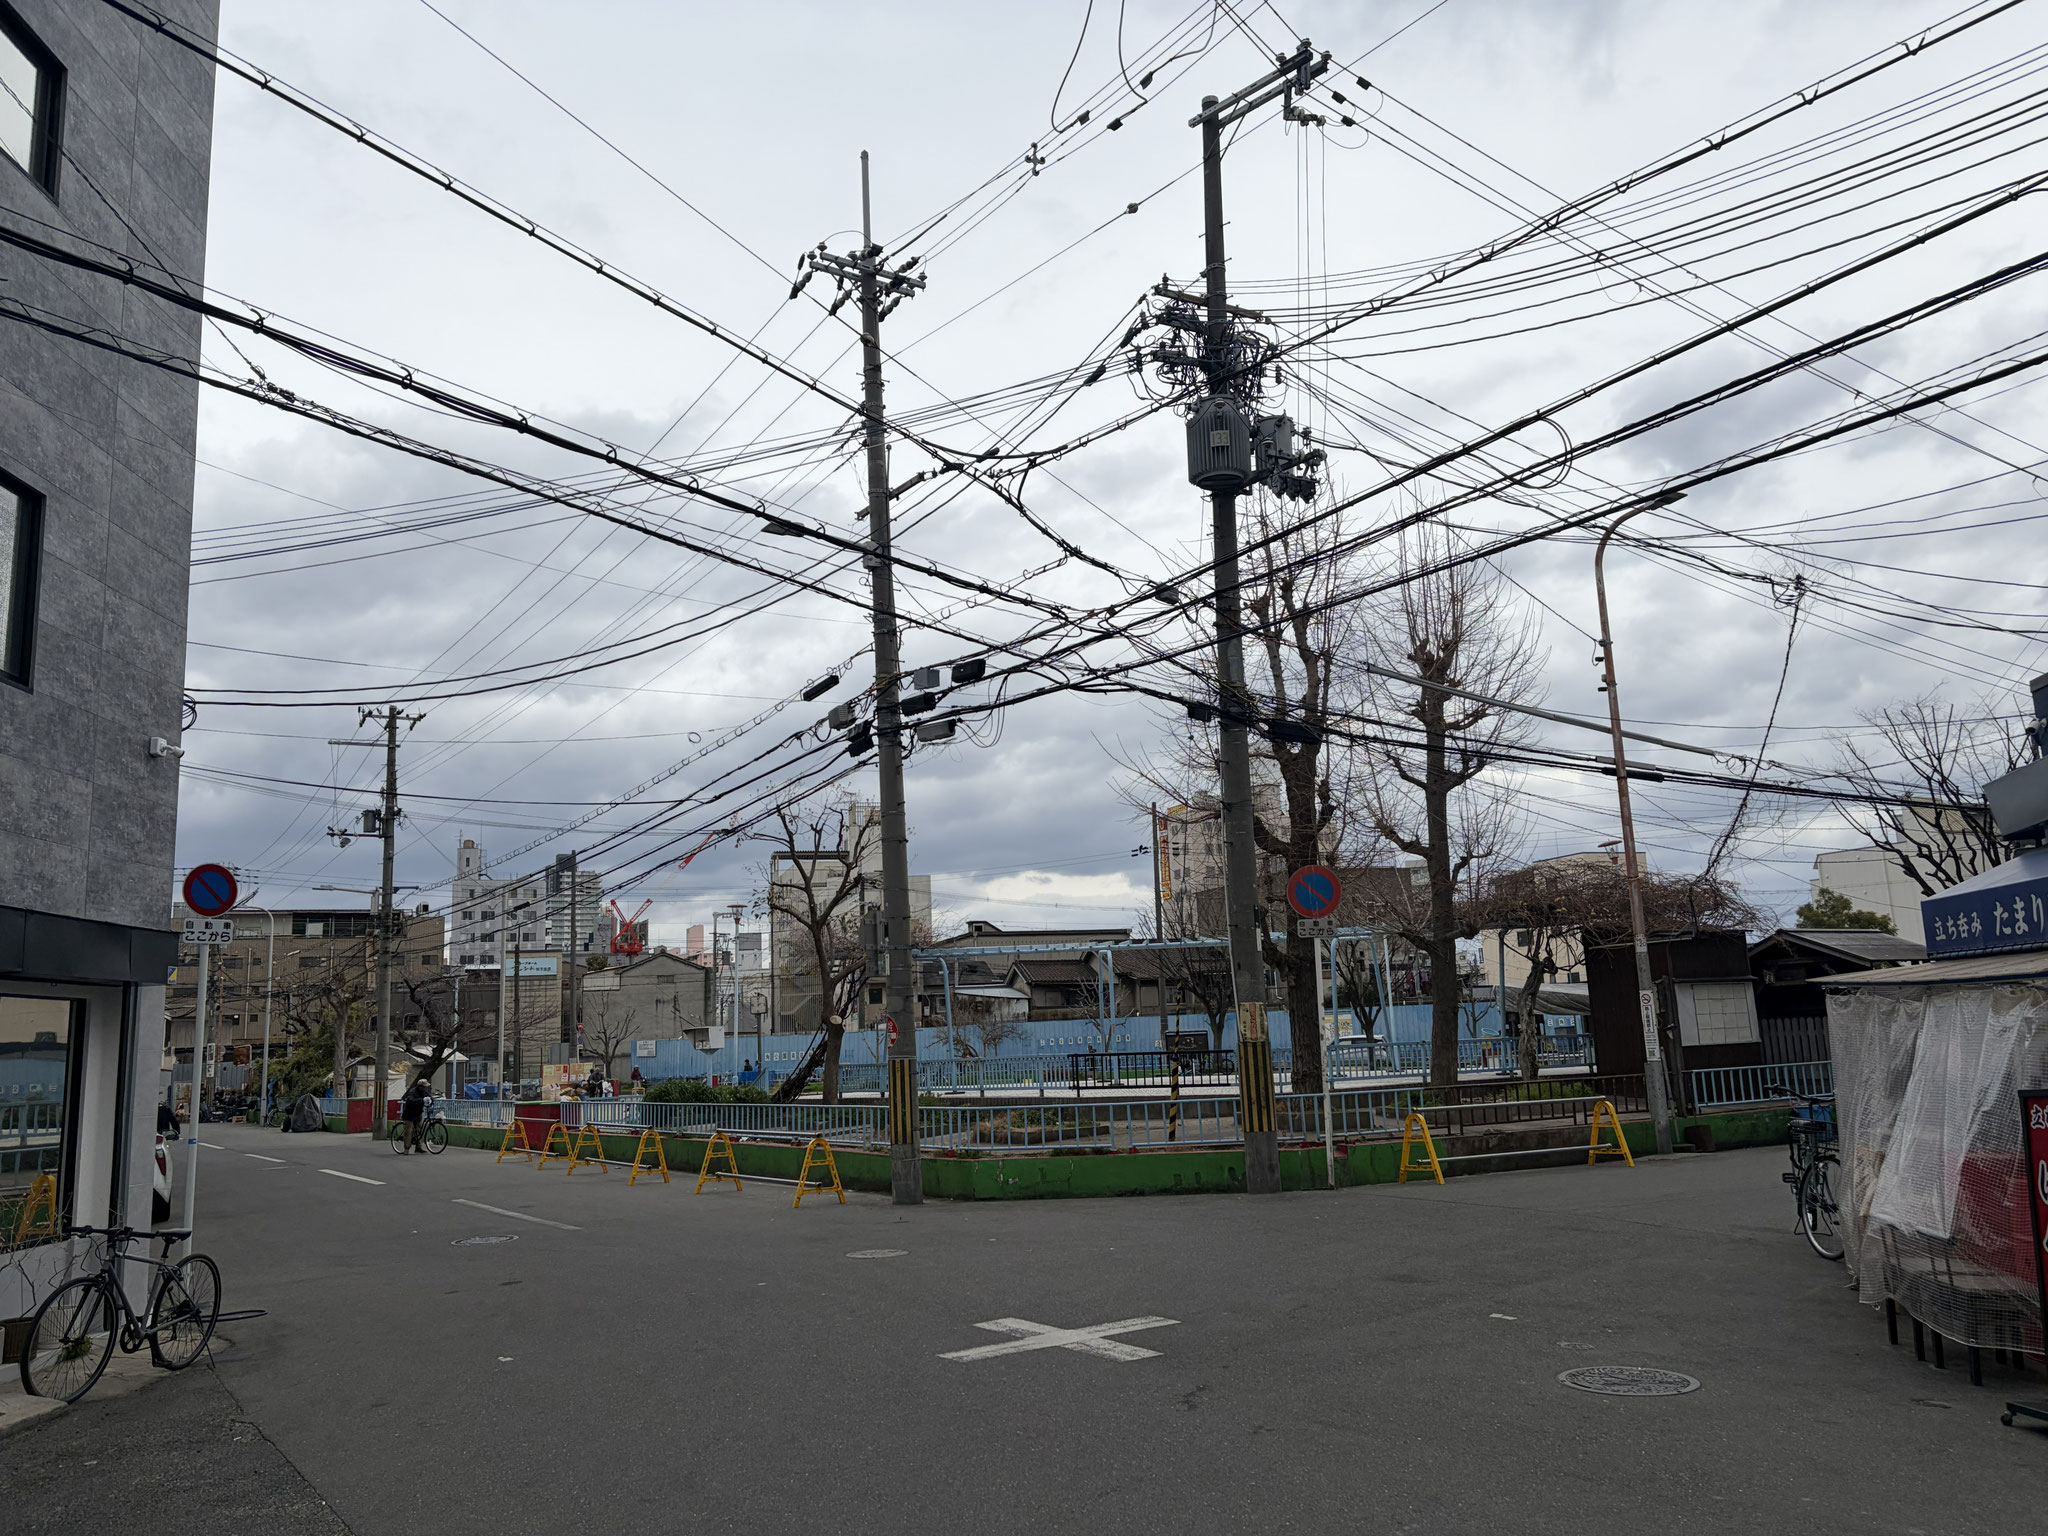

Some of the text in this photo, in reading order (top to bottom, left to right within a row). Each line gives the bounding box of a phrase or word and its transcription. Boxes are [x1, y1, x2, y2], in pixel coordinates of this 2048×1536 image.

[1211, 432, 1229, 446] 133
[1934, 893, 2048, 941] 立ち呑み たまり
[185, 921, 232, 930] 自動車
[1299, 919, 1333, 927] 自動車
[185, 931, 231, 942] ここから
[1299, 927, 1335, 937] ここから
[2031, 1104, 2048, 1130] 立
